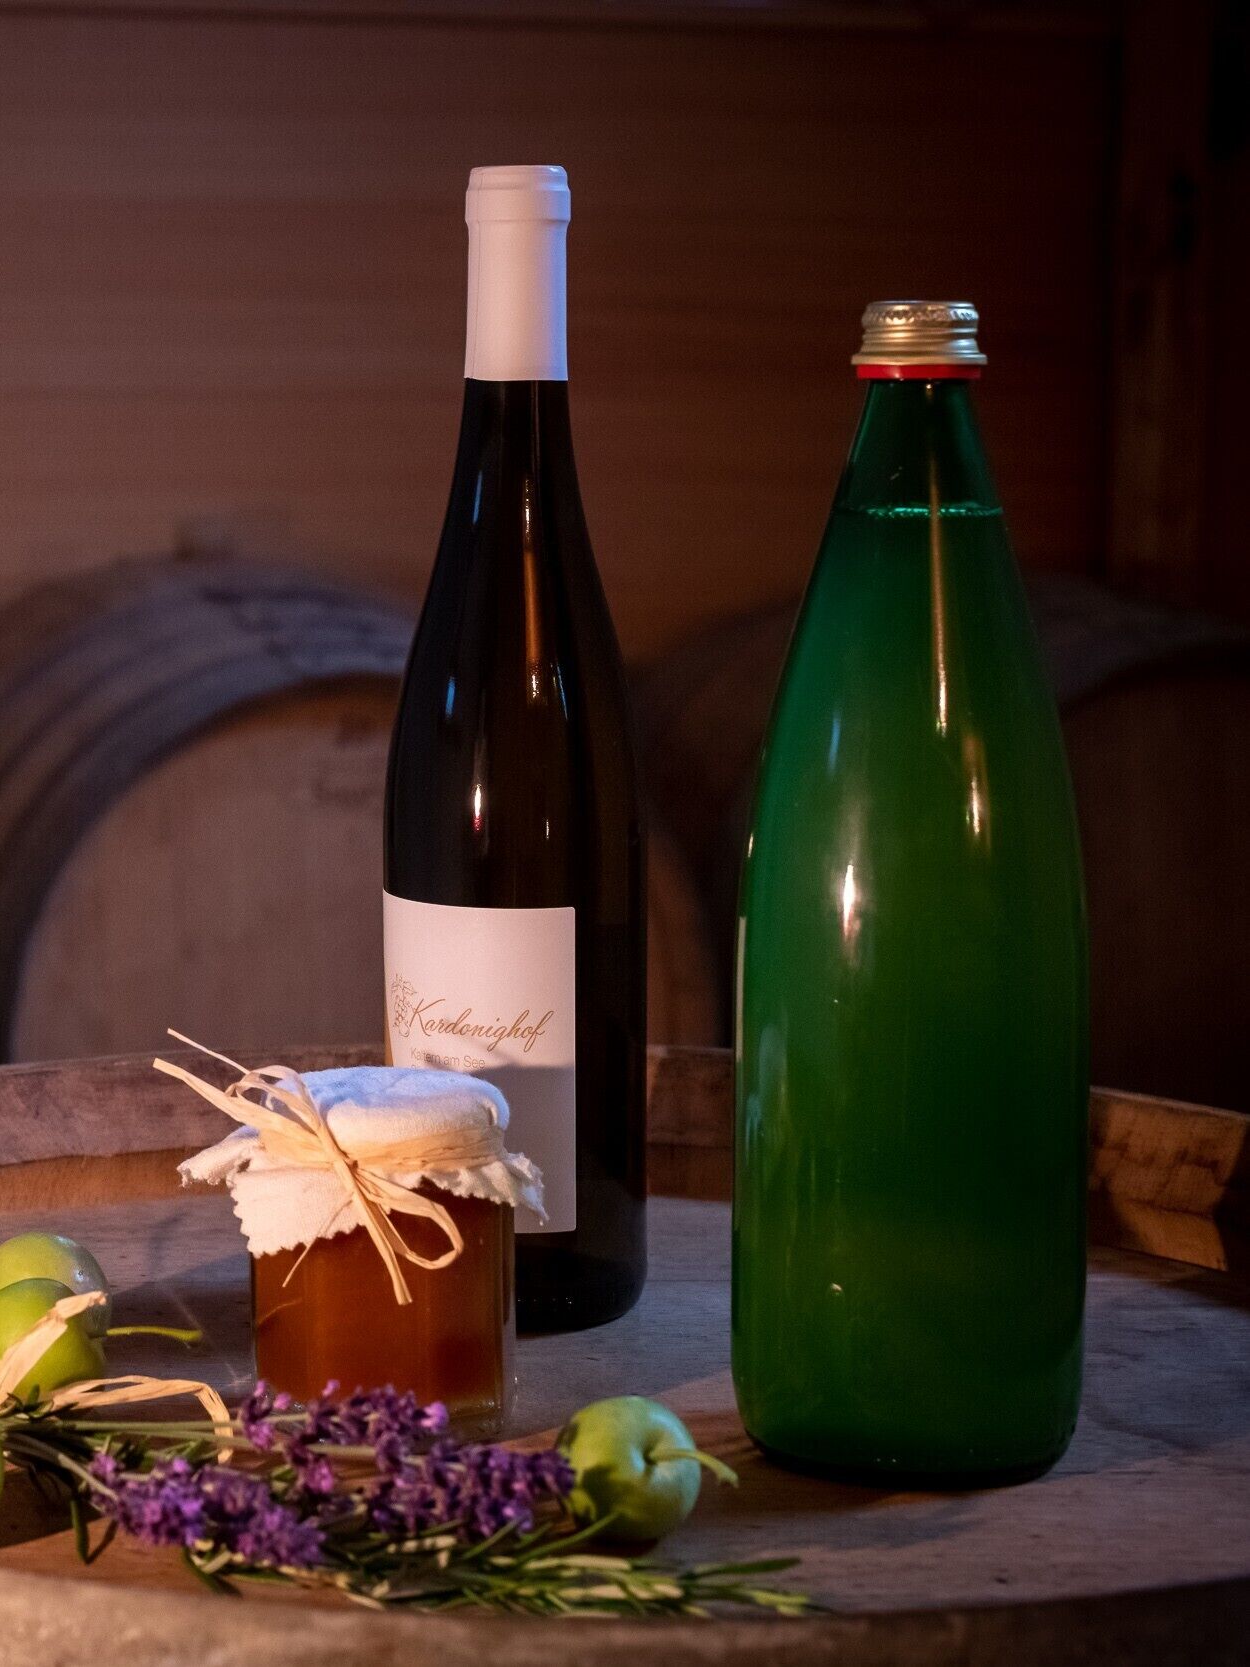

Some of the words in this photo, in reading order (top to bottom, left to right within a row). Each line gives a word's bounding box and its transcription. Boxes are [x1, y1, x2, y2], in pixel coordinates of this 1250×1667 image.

[409, 998, 554, 1052] Kardonighof
[411, 1047, 441, 1064] Katern
[443, 1056, 460, 1067] am
[463, 1055, 486, 1069] See
